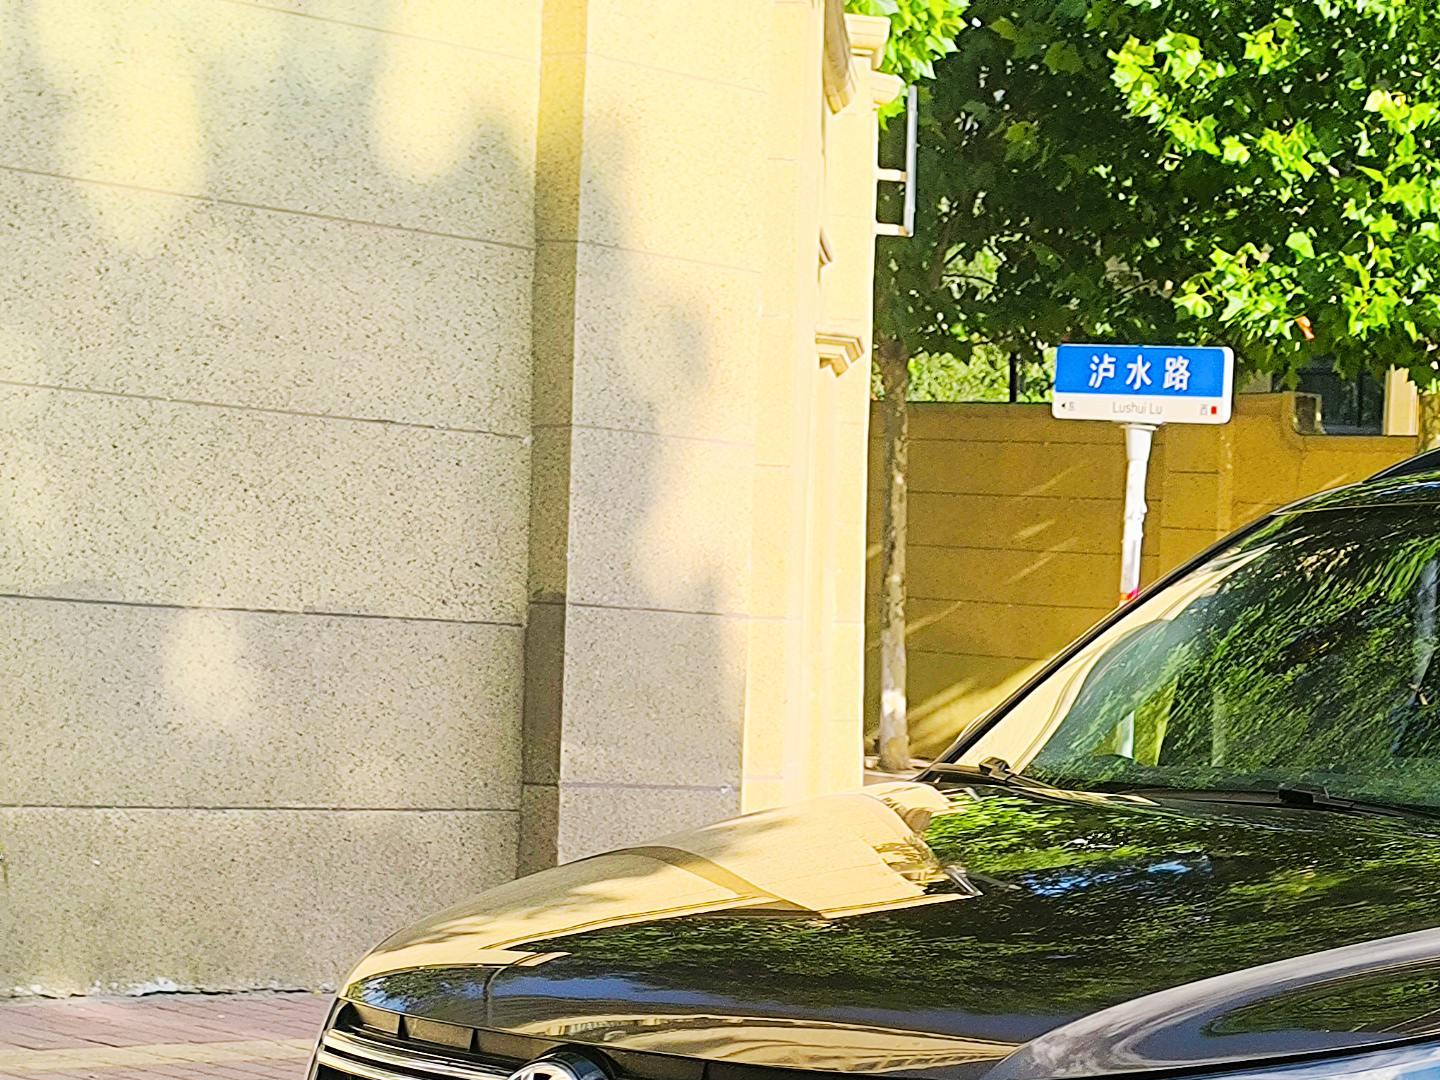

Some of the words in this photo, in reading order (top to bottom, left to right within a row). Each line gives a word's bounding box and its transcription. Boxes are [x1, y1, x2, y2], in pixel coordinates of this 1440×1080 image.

[1088, 353, 1191, 392] 泸水路
[1112, 400, 1147, 415] Lushui
[1149, 402, 1163, 416] Lu
